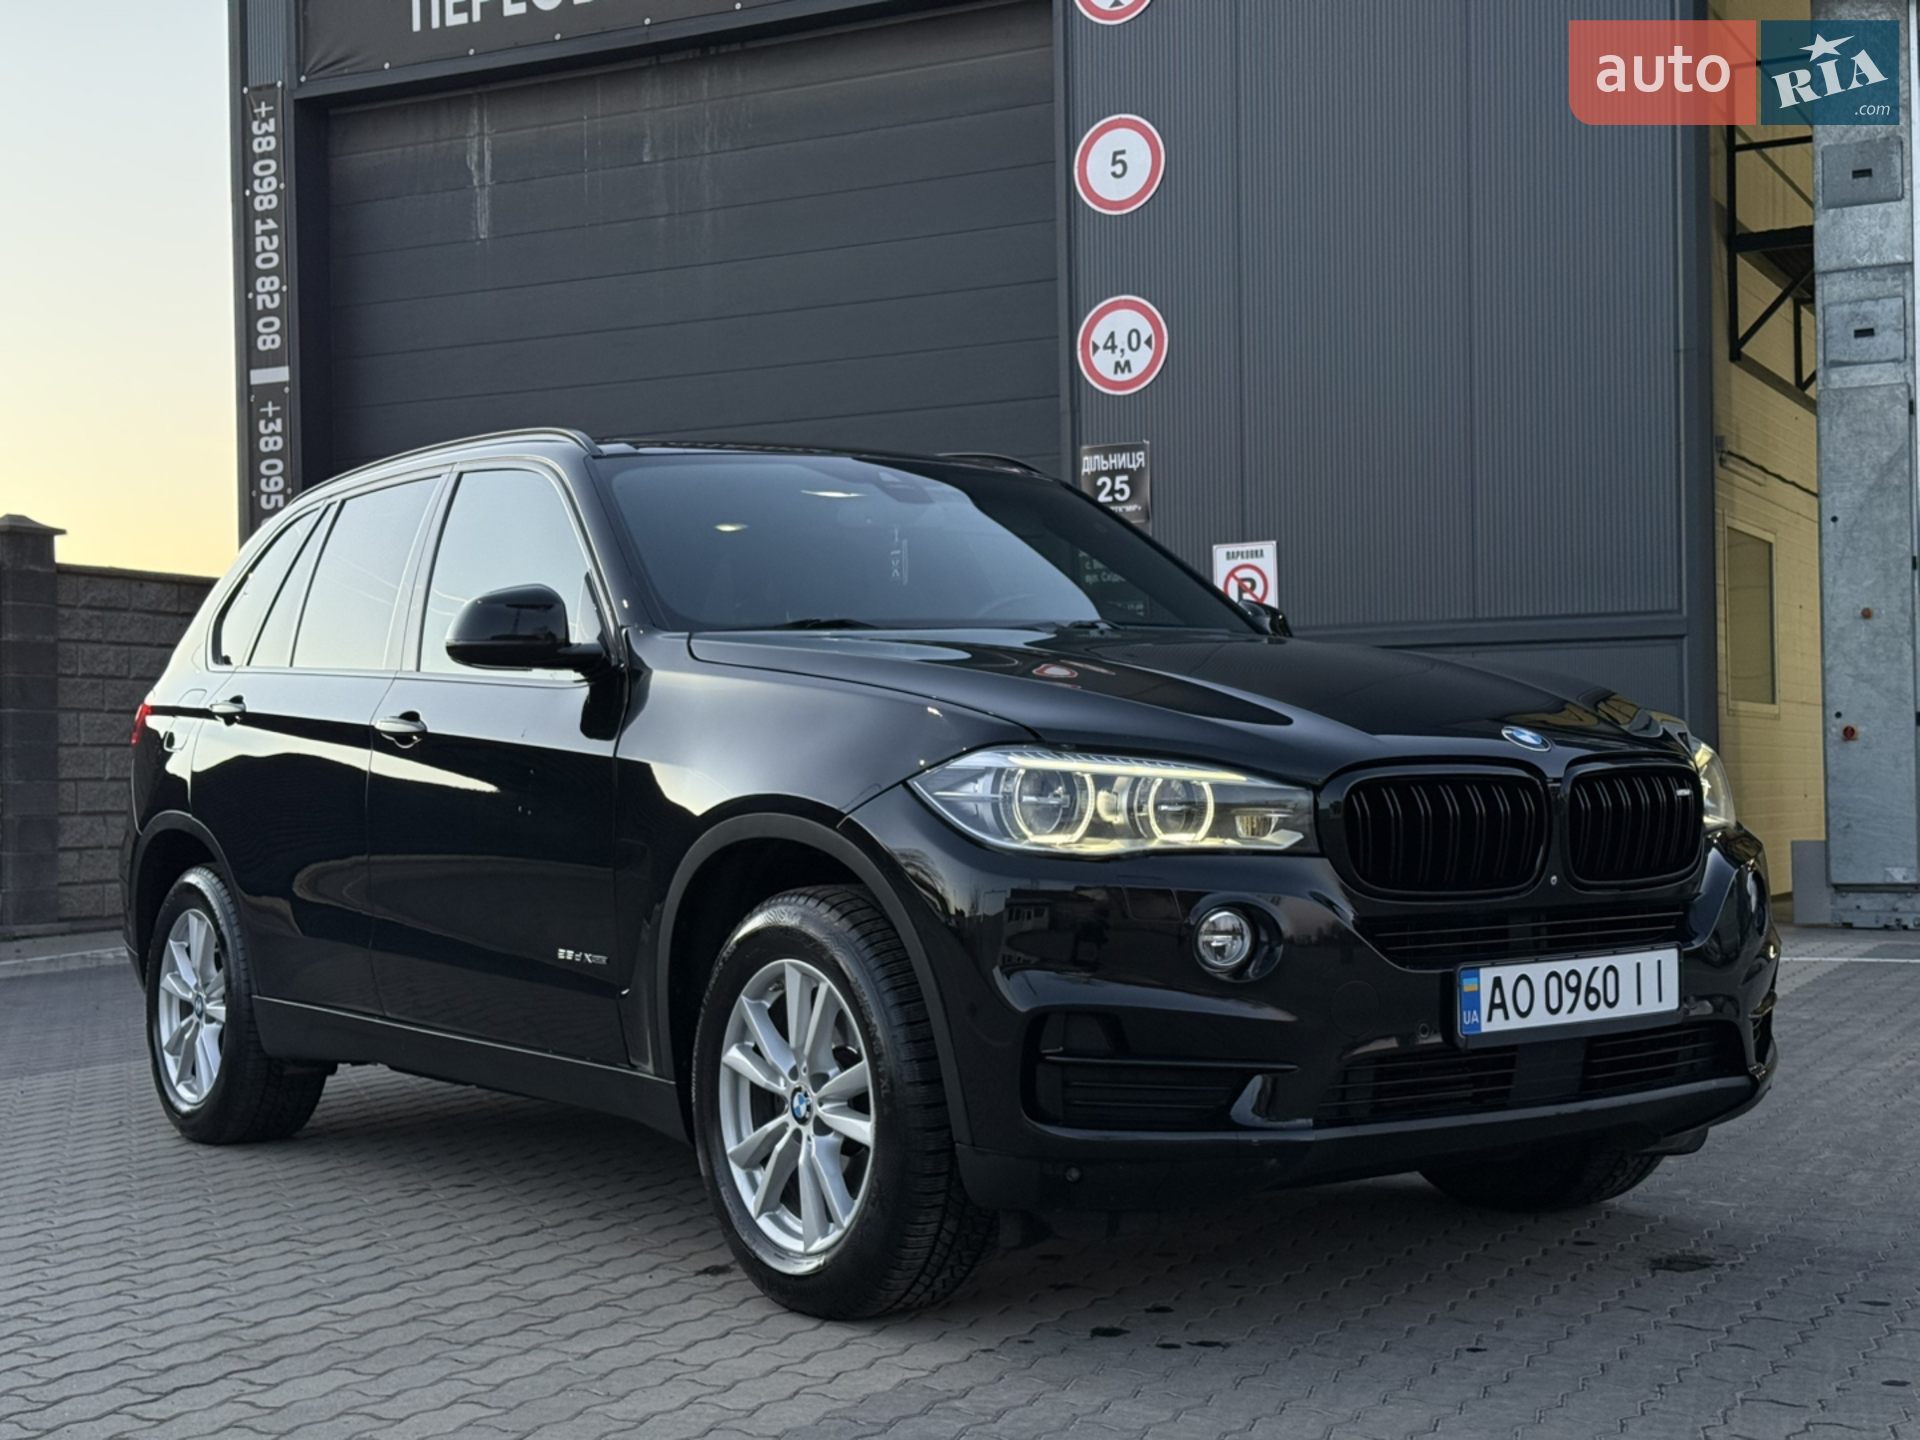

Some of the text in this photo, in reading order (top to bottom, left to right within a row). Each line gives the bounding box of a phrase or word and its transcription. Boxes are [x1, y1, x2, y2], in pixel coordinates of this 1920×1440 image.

[1110, 149, 1128, 179] 5
[252, 101, 281, 351] +38 098 120 82 08
[1102, 328, 1142, 358] 4,0
[258, 401, 284, 453] +38
[1082, 451, 1146, 476] ДІЛЬНИЦЯ
[259, 458, 285, 510] 095
[1096, 475, 1131, 503] 25
[1226, 549, 1265, 561] ПАРКОВКА
[1486, 973, 1535, 1023] AO
[1544, 964, 1620, 1016] 0960
[1463, 1010, 1479, 1025] UA
